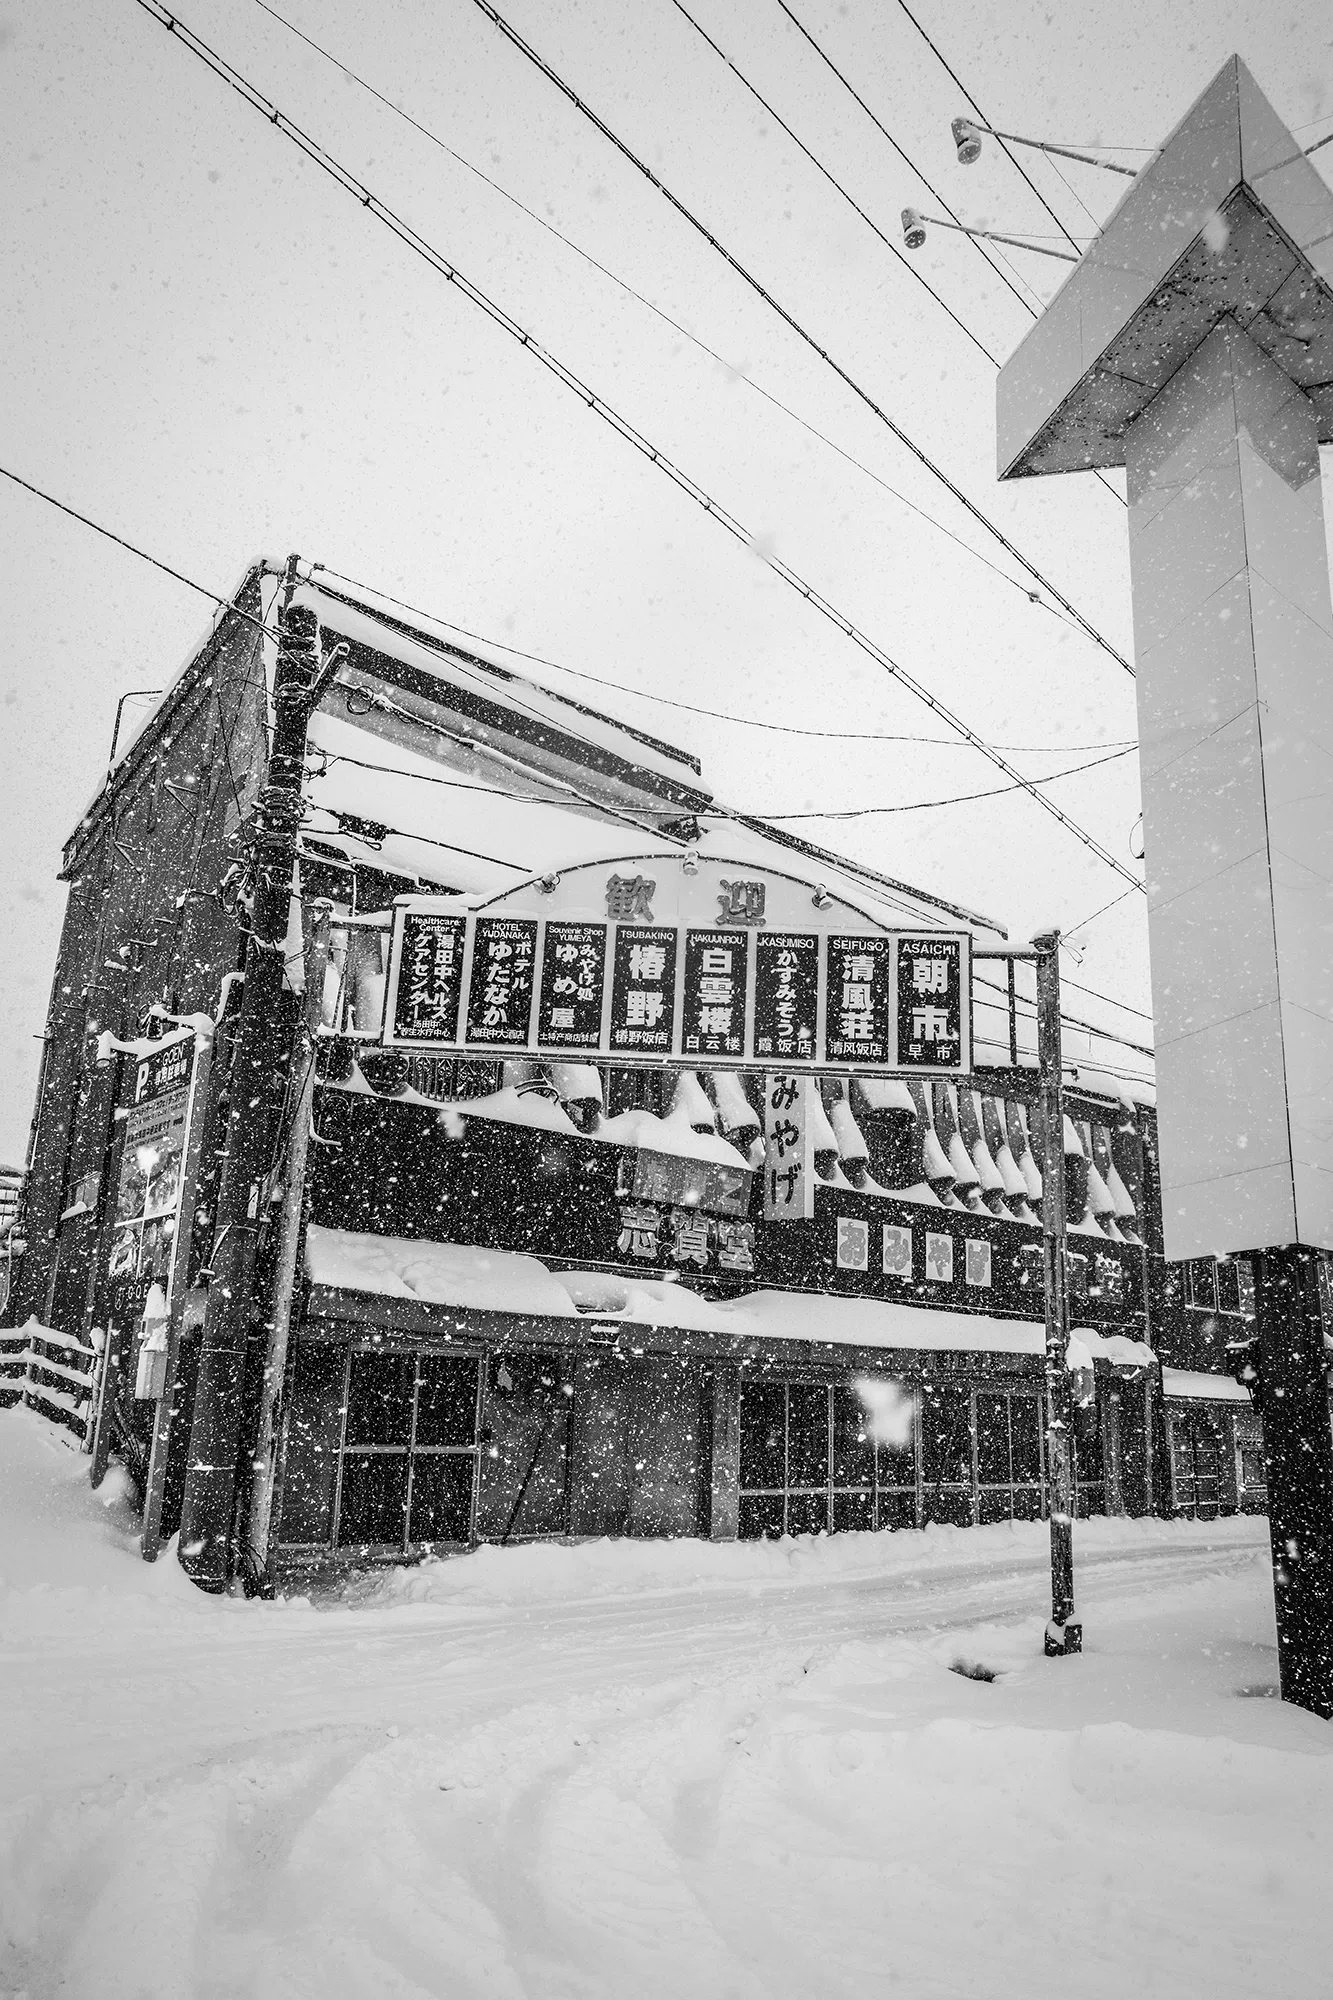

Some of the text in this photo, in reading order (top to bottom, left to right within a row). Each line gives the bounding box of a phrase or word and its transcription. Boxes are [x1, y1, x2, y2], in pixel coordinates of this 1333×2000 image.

[411, 916, 460, 926] Healthcare
[420, 924, 450, 933] Center
[492, 922, 521, 932] HOTEL
[482, 929, 531, 940] YUDANAKA
[548, 925, 604, 937] Souvenir Shop
[559, 934, 593, 942] YUMEYA
[620, 930, 674, 941] TSUBAKINO
[691, 934, 743, 945] HAKUUNROU
[761, 936, 814, 949] KASUMISO
[832, 940, 884, 952] SEIFUSO
[902, 943, 956, 955] ASAICHI
[511, 941, 532, 990] ホテル
[408, 932, 433, 1020] ケアセンター
[550, 943, 579, 1029] ゆめ屋
[626, 944, 666, 1027] 椿野
[698, 947, 733, 1035] 白雲楼
[773, 949, 798, 1037] かすみそう
[840, 954, 875, 1040] 清風荘
[912, 957, 949, 1041] 朝市
[686, 1034, 741, 1051] 白云楼
[908, 1043, 953, 1060] 早市
[135, 1062, 149, 1103] P
[770, 1075, 802, 1204] みやげ
